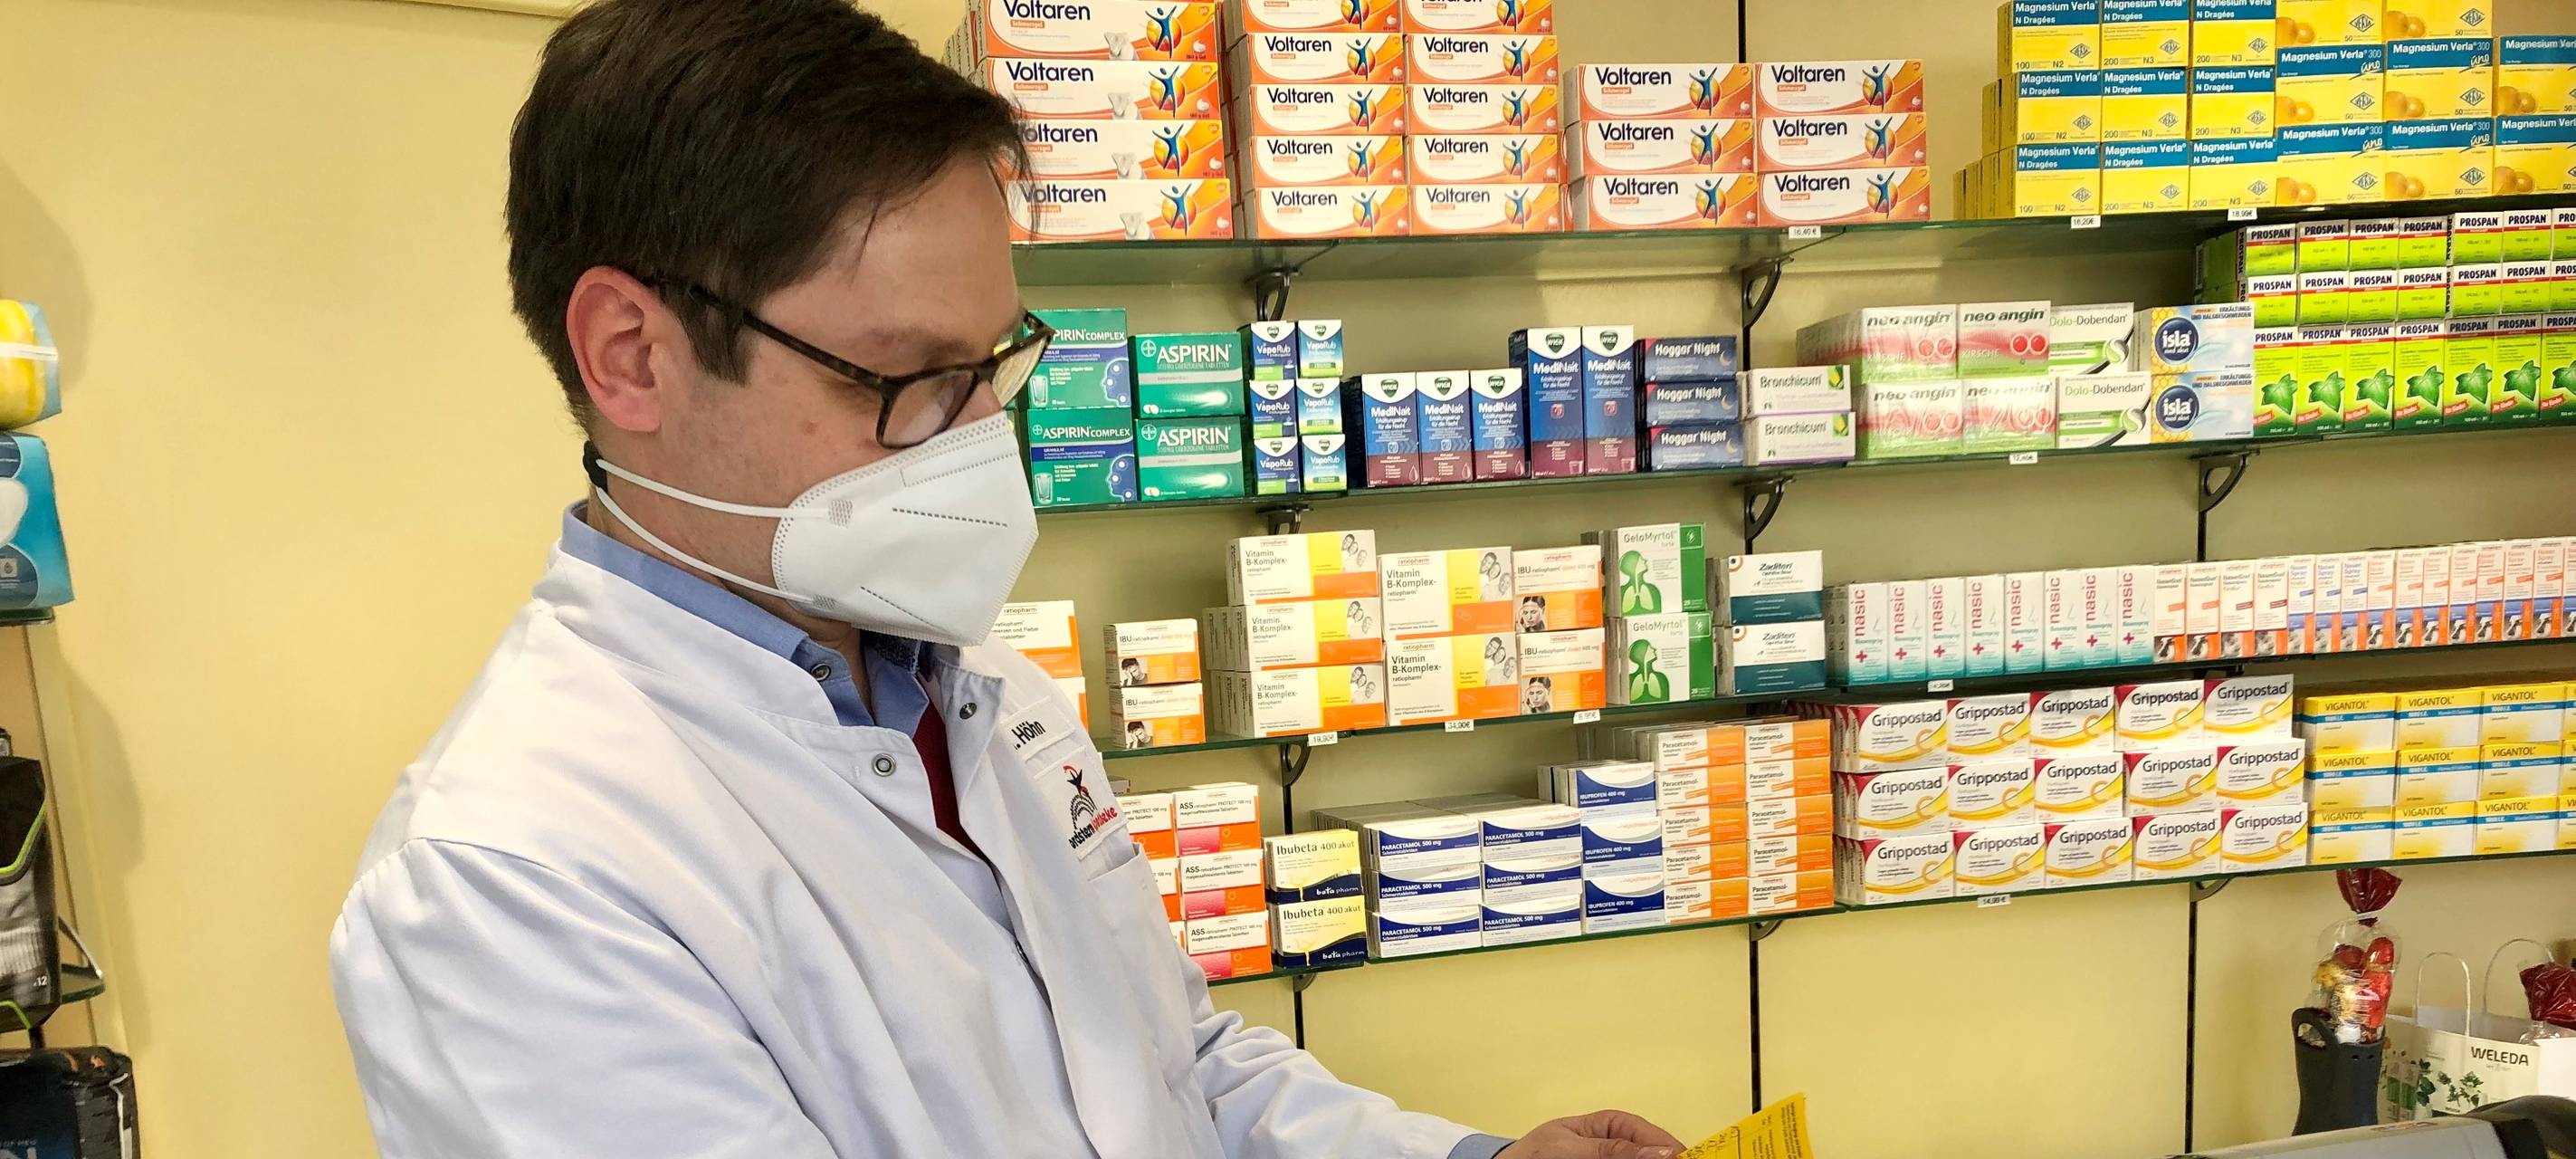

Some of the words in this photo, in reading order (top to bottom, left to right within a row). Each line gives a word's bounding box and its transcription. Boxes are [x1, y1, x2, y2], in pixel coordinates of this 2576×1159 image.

[1004, 0, 1091, 21] Voltaren
[2016, 1, 2068, 13] Magnesium
[2016, 15, 2022, 24] N
[2023, 14, 2056, 24] Dragées
[1265, 35, 1332, 53] Voltaren
[1423, 36, 1488, 54] Voltaren
[2392, 43, 2449, 56] Magnesium
[2476, 41, 2491, 52] 300
[2104, 57, 2119, 66] 200
[2281, 51, 2338, 64] Magnesium
[2368, 48, 2381, 59] 300
[1006, 61, 1094, 81] Voltaren
[1595, 66, 1672, 86] Voltaren
[2021, 72, 2074, 84] Magnesium
[2104, 72, 2157, 83] Magnesium
[2196, 70, 2247, 81] Magnesium
[1267, 87, 1334, 104] Voltaren
[2113, 85, 2142, 94] Dragées
[1598, 122, 1674, 142] Voltaren
[2392, 123, 2448, 137] Magnesium
[2476, 120, 2490, 131] 300
[1424, 138, 1489, 155] Voltaren
[2193, 142, 2247, 154] Magnesium
[1603, 177, 1679, 197] Voltaren
[1774, 173, 1850, 195] Voltaren
[1020, 183, 1106, 204] Voltaren
[1271, 189, 1338, 206] Voltaren
[1426, 187, 1490, 204] Voltaren
[2460, 216, 2498, 228] PROSPAN
[2251, 228, 2291, 240] PROSPAN
[2304, 224, 2344, 235] PROSPAN
[2404, 273, 2442, 283] PROSPAN
[2507, 266, 2545, 277] PROSPAN
[2253, 280, 2292, 292] PROSPAN
[1963, 311, 1995, 322] neo
[1998, 308, 2044, 323] angin
[2049, 315, 2127, 327] Dolo-Dobendan
[2497, 319, 2536, 330] PROSPAN
[1086, 330, 1125, 341] COMPLEX
[2162, 329, 2191, 348] isla
[2255, 331, 2294, 343] PROSPAN
[2350, 327, 2390, 338] PROSPAN
[1306, 340, 1336, 352] VapoRub
[1695, 342, 1721, 357] Night
[1157, 344, 1229, 364] ASPIRIN
[1533, 361, 1579, 374] MediNait
[1588, 359, 1631, 372] MediNait
[2065, 383, 2144, 397] Dolo-Dobendan
[1304, 398, 1334, 409] VapoRub
[1478, 402, 1517, 413] MediNait
[2162, 397, 2191, 416] isla
[1371, 407, 1411, 417] MediNait
[1043, 426, 1090, 440] ASPIRIN
[1091, 427, 1131, 438] COMPLEX
[1157, 426, 1229, 446] ASPIRIN
[1700, 430, 1726, 445] Night
[1311, 455, 1340, 467] VapoRub
[1245, 550, 1274, 558] Vitamin
[1387, 569, 1420, 579] Vitamin
[2119, 572, 2133, 619] nasic
[1929, 584, 1943, 631] nasic
[2007, 580, 2021, 627] nasic
[1850, 589, 1865, 637] nasic
[1252, 617, 1281, 625] Vitamin
[1391, 654, 1426, 664] Vitamin
[2218, 684, 2287, 701] Grippostad
[2492, 691, 2534, 702] VIGANTOL
[2042, 696, 2109, 714] Grippostad
[2325, 701, 2367, 711] VIGANTOL
[1872, 710, 1942, 728] Grippostad
[1012, 720, 1046, 746] Höhn
[2142, 755, 2211, 774] Grippostad
[2409, 752, 2451, 763] VIGANTOL
[1957, 769, 2028, 787] Grippostad
[2485, 802, 2527, 812] VIGANTOL
[2235, 814, 2302, 830] Grippostad
[2323, 811, 2364, 822] VIGANTOL
[1485, 832, 1523, 842] PARACETAMOL
[1536, 829, 1544, 838] mg
[2059, 828, 2127, 845] Grippostad
[1276, 843, 1318, 854] Ibubeta
[1321, 841, 1337, 850] 400
[1339, 839, 1355, 848] akut
[1381, 841, 1420, 851] PARACETAMOL
[1422, 839, 1432, 848] 500
[1433, 839, 1442, 848] mg
[1877, 842, 1948, 860] Grippostad
[1486, 875, 1524, 884] PARACETAMOL
[1525, 874, 1535, 882] 500
[1536, 872, 1544, 881] mg
[1283, 907, 1324, 918] Ibubeta
[1327, 906, 1343, 915] 400
[1345, 904, 1361, 914] akut
[1382, 927, 1421, 937] PARACETAMOL
[1433, 924, 1442, 934] mg
[2470, 1046, 2530, 1066] WELEDA
